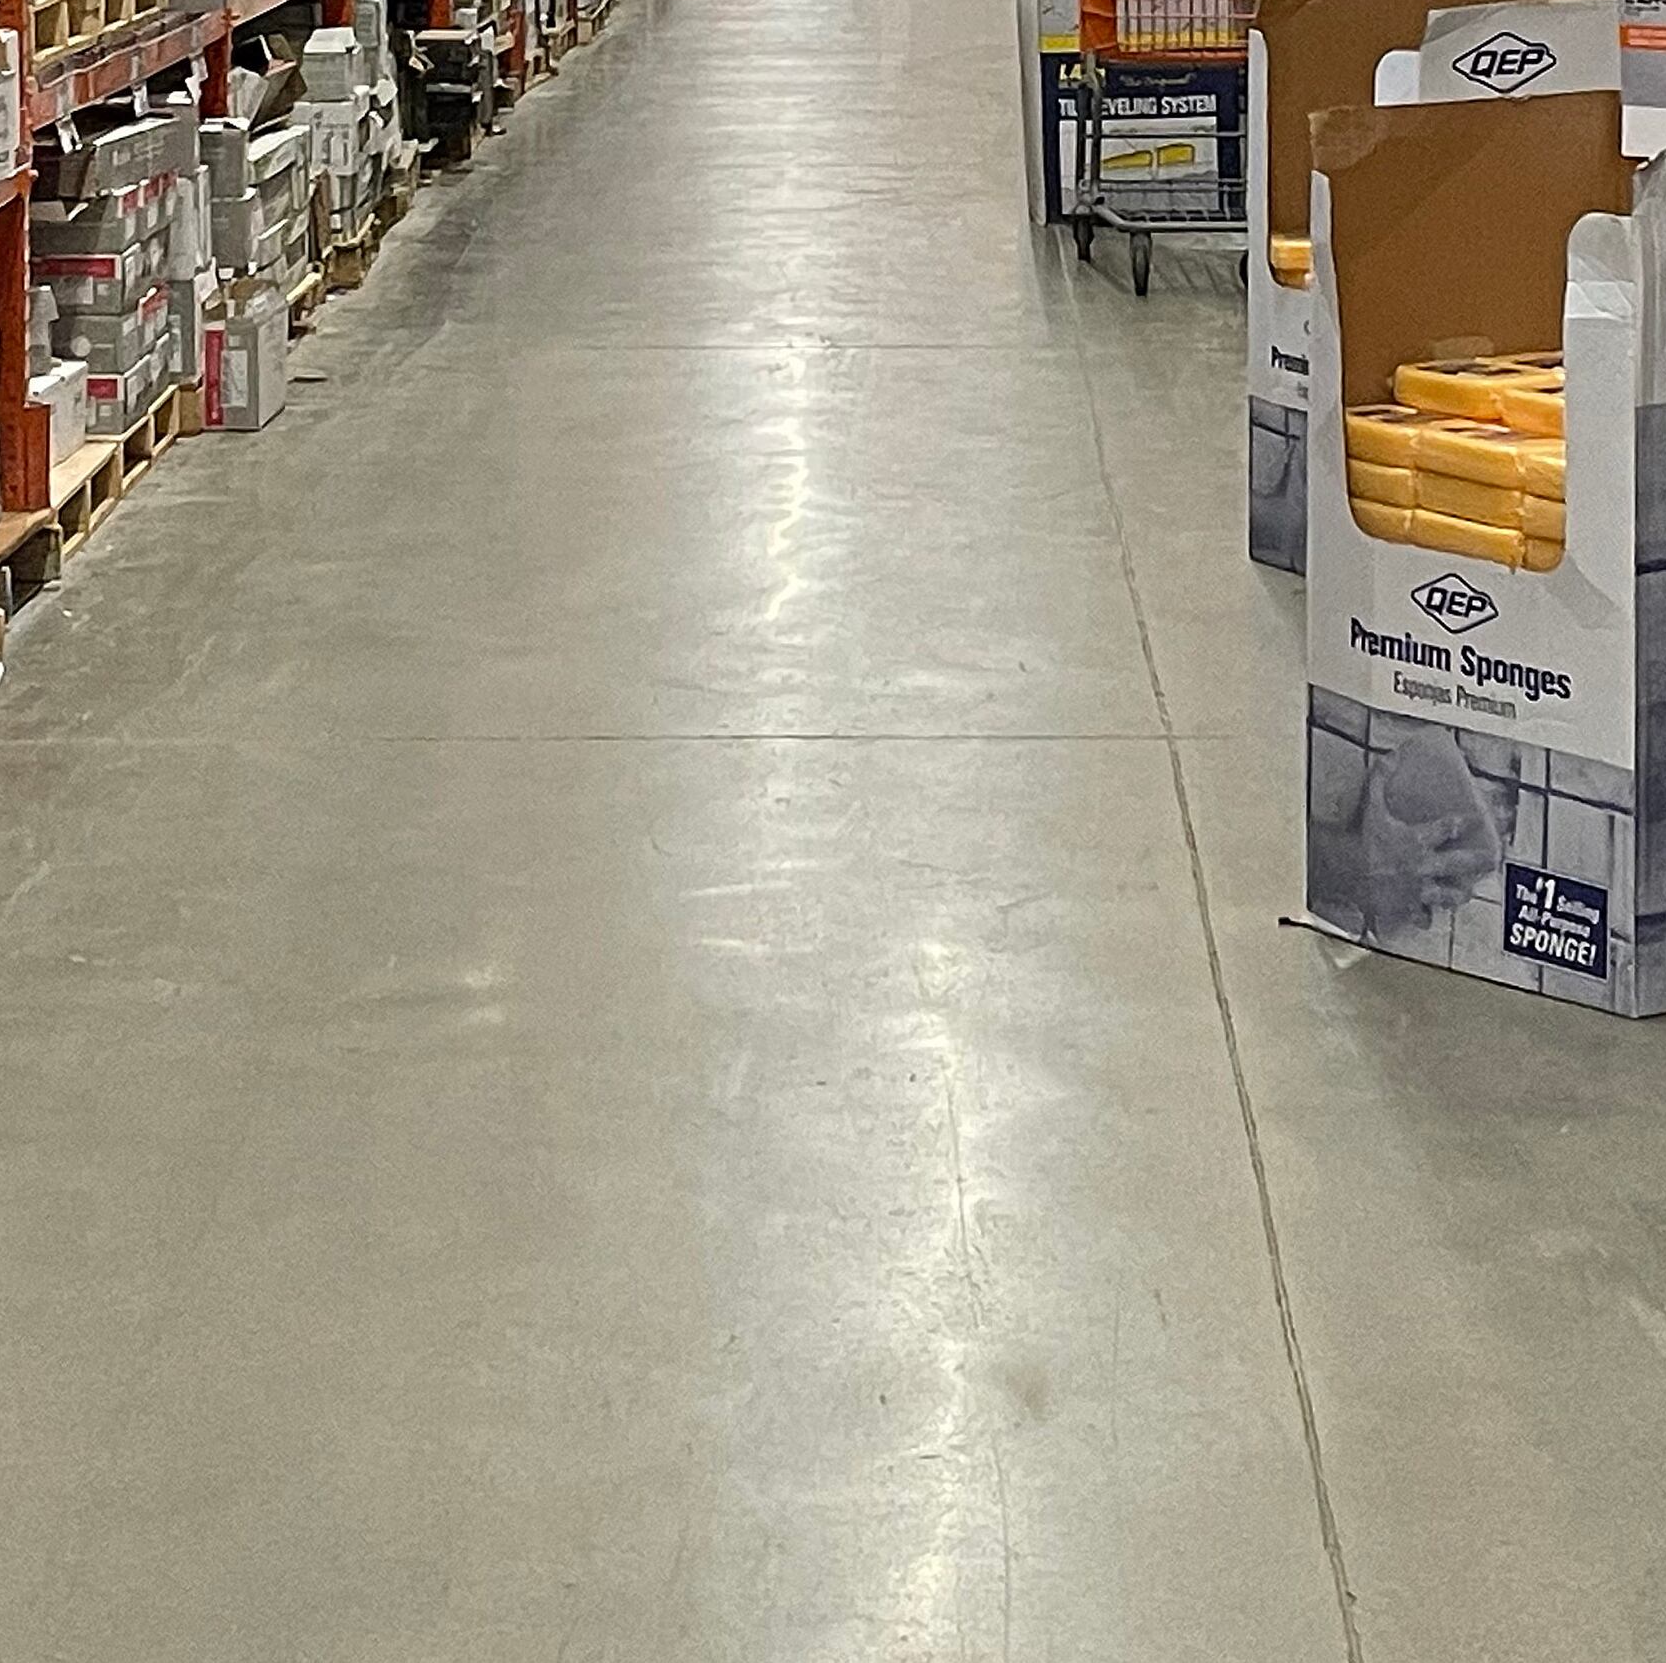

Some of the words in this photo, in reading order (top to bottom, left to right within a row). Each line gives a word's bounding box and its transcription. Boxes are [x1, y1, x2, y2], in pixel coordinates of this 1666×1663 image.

[1469, 48, 1545, 78] QEP
[1097, 96, 1157, 117] EVELING
[1160, 94, 1218, 116] SYSTEM
[1424, 586, 1489, 618] QEP
[1350, 617, 1452, 673] Premium
[1459, 644, 1573, 702] Sponges
[1509, 923, 1598, 967] SPONGE!
